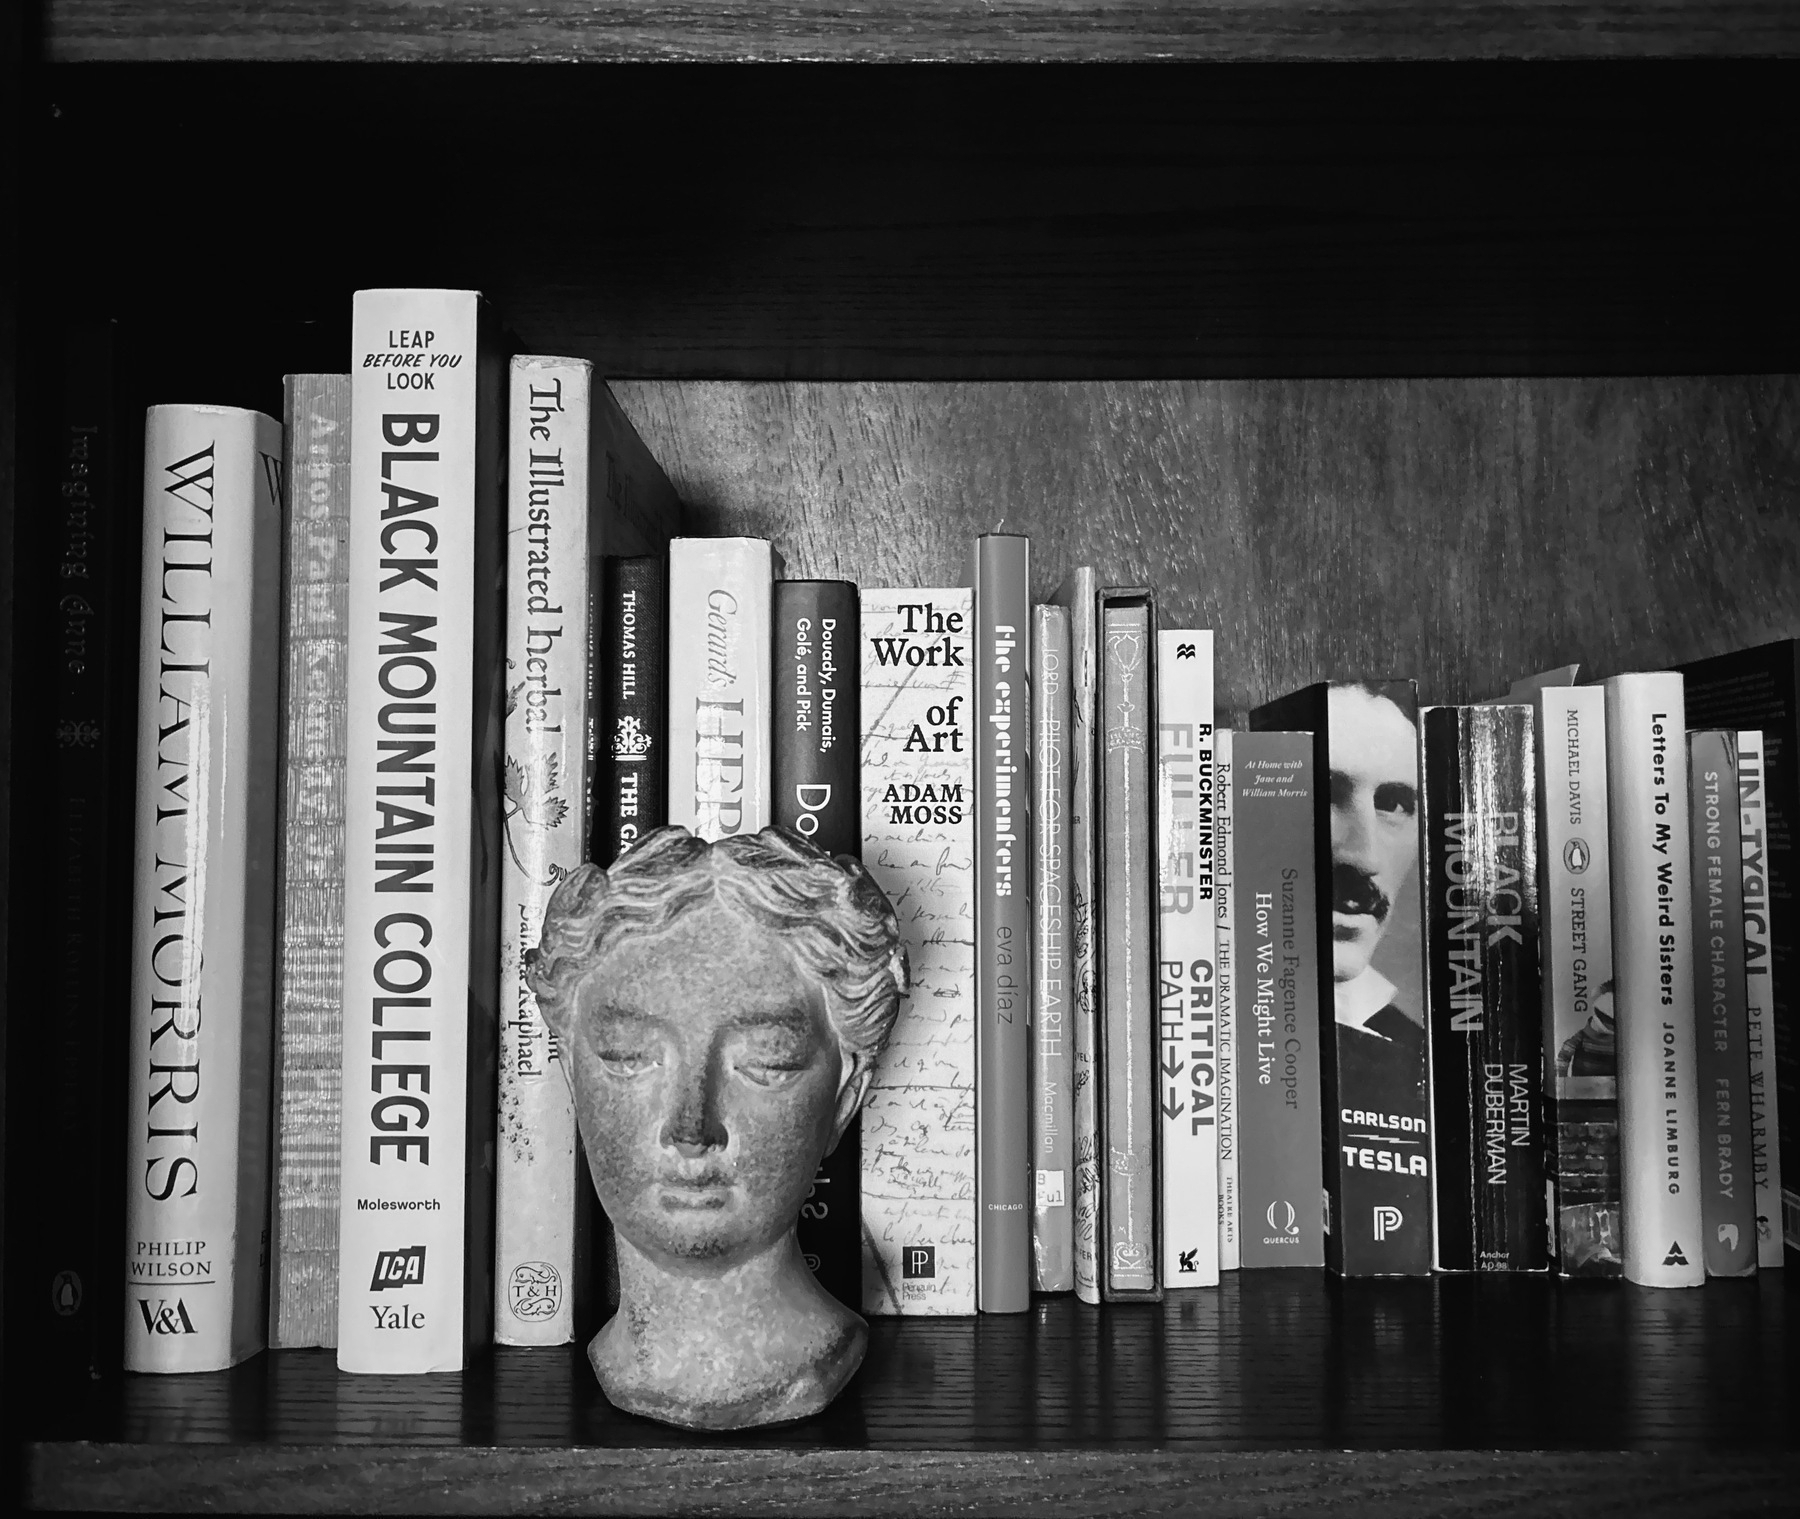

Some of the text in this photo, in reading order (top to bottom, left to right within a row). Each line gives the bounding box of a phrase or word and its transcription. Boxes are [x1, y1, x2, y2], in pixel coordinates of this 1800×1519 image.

[362, 353, 463, 369] BEFORE YOU
[389, 330, 435, 349] LEAP
[387, 372, 435, 391] LOOK
[528, 377, 565, 442] The
[526, 447, 565, 617] Illustrated
[706, 589, 738, 688] Gerard's
[897, 602, 964, 633] The
[622, 590, 636, 700] THOMAS HILL
[870, 636, 964, 667] Work
[795, 617, 812, 732] Golé, and Pick
[818, 619, 837, 753] Douady, Dumais,
[926, 695, 964, 727] of
[902, 724, 964, 753] Art
[1216, 763, 1231, 811] Robert
[1253, 773, 1294, 785] Jane and
[1257, 760, 1282, 769] Home
[1283, 760, 1303, 769] with
[370, 413, 441, 1167] BLACK MOUNTAIN COLLEGE
[619, 772, 638, 818] THE
[795, 784, 832, 837] Do
[881, 783, 964, 803] ADAM
[1199, 723, 1213, 901] R. BUCKMINSTER
[1242, 788, 1308, 797] William Morris
[145, 440, 215, 1201] WILLIAM MORRIS
[889, 805, 963, 825] MOSS
[989, 625, 1018, 1026] the experimenters eva díaz
[1217, 816, 1232, 876] Edmond
[1566, 709, 1589, 1013] MICHAEL DAVIS STREET GANG
[1040, 649, 1062, 1154] LORD PILOT FOR SPACESHIP EARTH Macmillan
[1214, 882, 1232, 919] Jones
[1486, 811, 1523, 947] BLACK
[1443, 813, 1484, 1032] MOUNTAIN
[1219, 941, 1231, 972] THE
[1651, 713, 1680, 1195] Letters To My Weird Sisters JOANNE LIMBURG
[1160, 960, 1184, 1041] PATH
[1252, 892, 1277, 1085] How We Might Live
[1278, 867, 1302, 1109] Suzanne Fagence Cooper
[1704, 770, 1734, 1199] STRONG FEMALE CHARACTER FERN BRADY
[1219, 975, 1232, 1053] DRAMATIC
[1747, 1007, 1763, 1061] PETE
[1190, 959, 1214, 1136] CRITICAL
[1220, 1057, 1233, 1161] IMAGINATION
[1341, 1108, 1427, 1134] CARLSON
[1484, 1064, 1507, 1185] DUBERMAN
[1508, 1063, 1531, 1146] MARTIN
[1749, 1070, 1769, 1190] WHARMBY
[1342, 1145, 1428, 1177] TESLA
[357, 1198, 441, 1211] Molesworth
[988, 1203, 1024, 1211] CHICAGO
[137, 1241, 206, 1256] PHILIP
[1263, 1236, 1300, 1245] QUERCUS
[1480, 1250, 1510, 1259] Anchor
[131, 1260, 212, 1276] WILSON
[378, 1255, 421, 1281] ICA
[512, 1285, 556, 1297] T & H
[137, 1297, 199, 1336] V&A
[369, 1303, 426, 1330] Yale
[902, 1291, 927, 1301] Press
